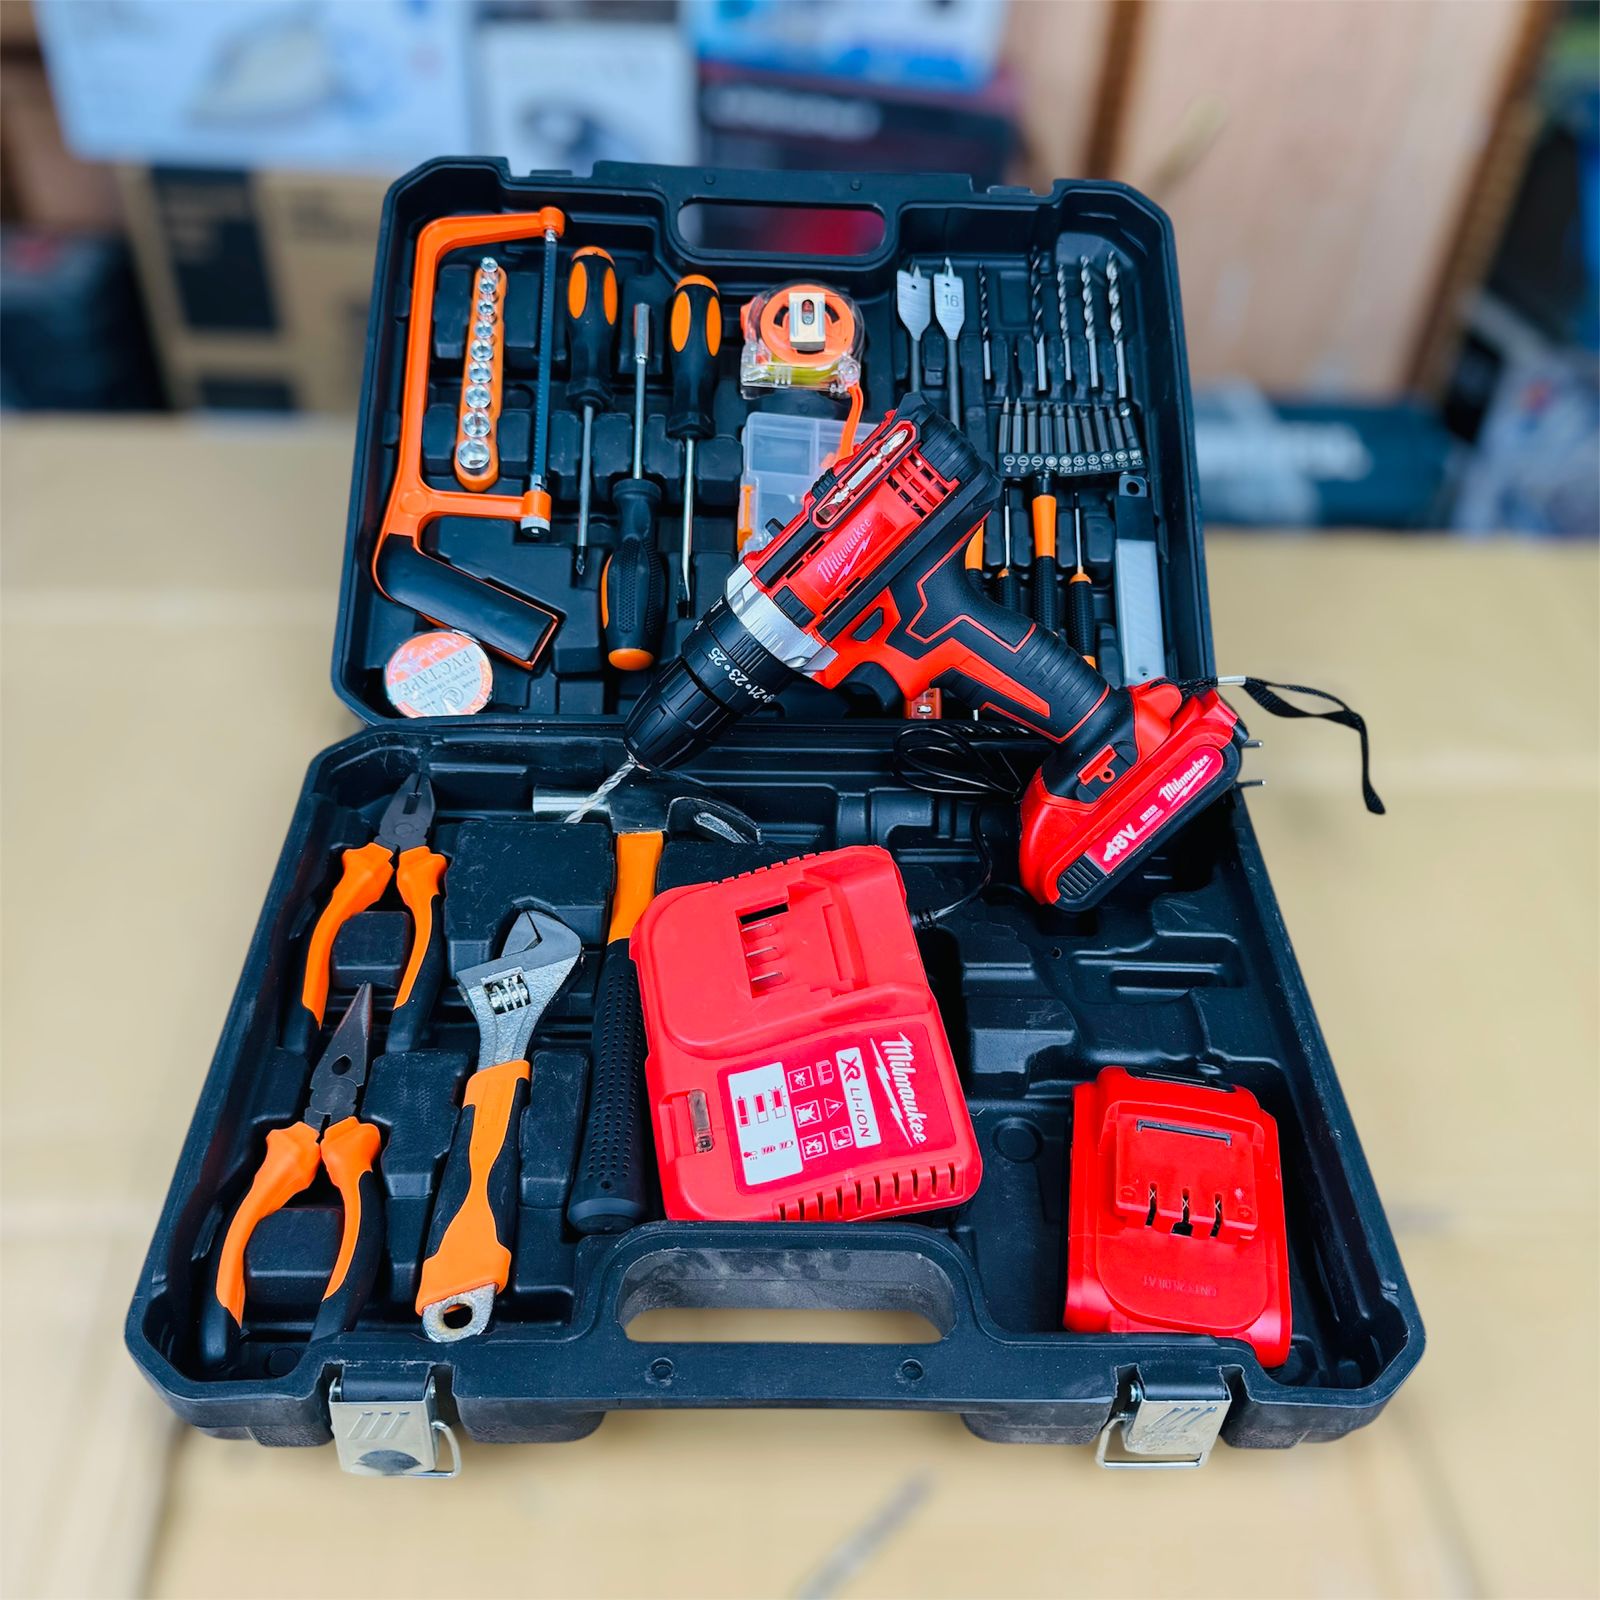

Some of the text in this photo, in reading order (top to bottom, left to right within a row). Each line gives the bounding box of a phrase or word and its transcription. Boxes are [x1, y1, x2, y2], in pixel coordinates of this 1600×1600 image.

[943, 294, 959, 307] 16
[1088, 464, 1101, 472] PH2
[707, 646, 728, 667] 25
[728, 668, 749, 687] 23
[747, 685, 767, 700] 21
[1103, 823, 1137, 862] 48V
[841, 1056, 871, 1138] XR LI-ION
